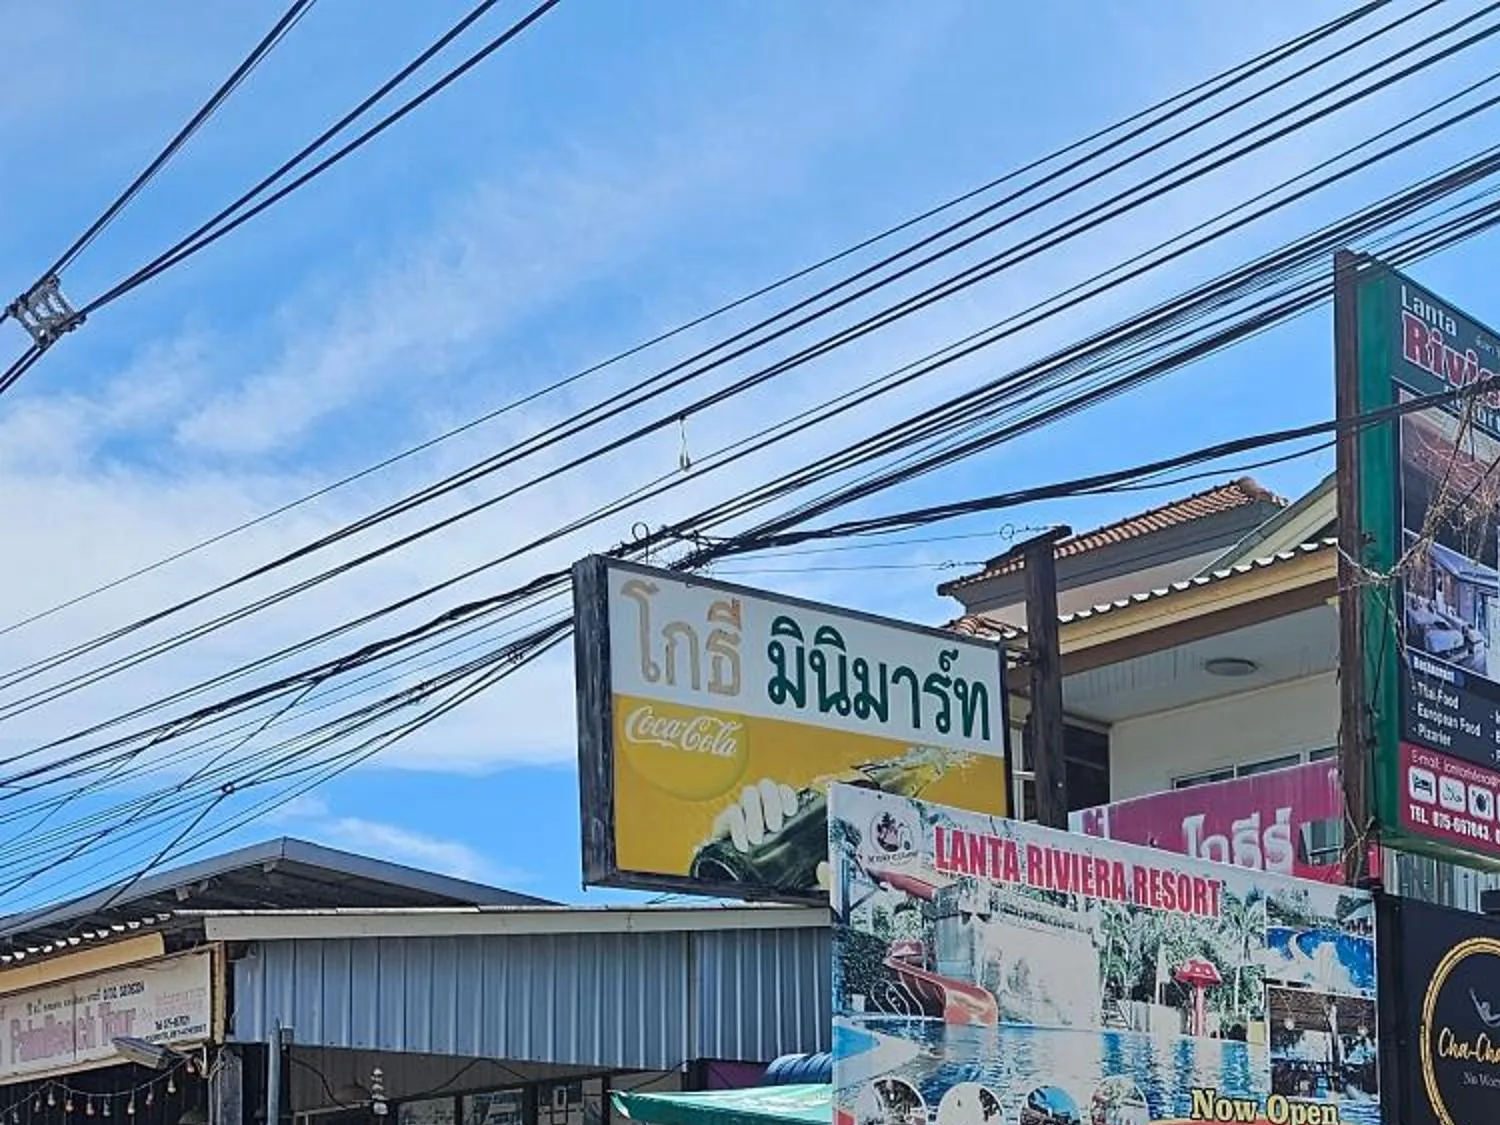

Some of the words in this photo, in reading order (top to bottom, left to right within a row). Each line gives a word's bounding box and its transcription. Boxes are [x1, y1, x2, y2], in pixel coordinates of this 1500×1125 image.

[1401, 285, 1457, 336] Lanta
[767, 615, 990, 741] มินิมาร์ท
[1438, 688, 1459, 710] Food
[624, 704, 743, 758] Coca-Cola
[1460, 717, 1481, 737] Food
[934, 825, 1020, 881] LANTA
[1025, 844, 1128, 900] RIVIERA
[1132, 864, 1222, 918] RESORT
[1190, 1087, 1257, 1123] Now
